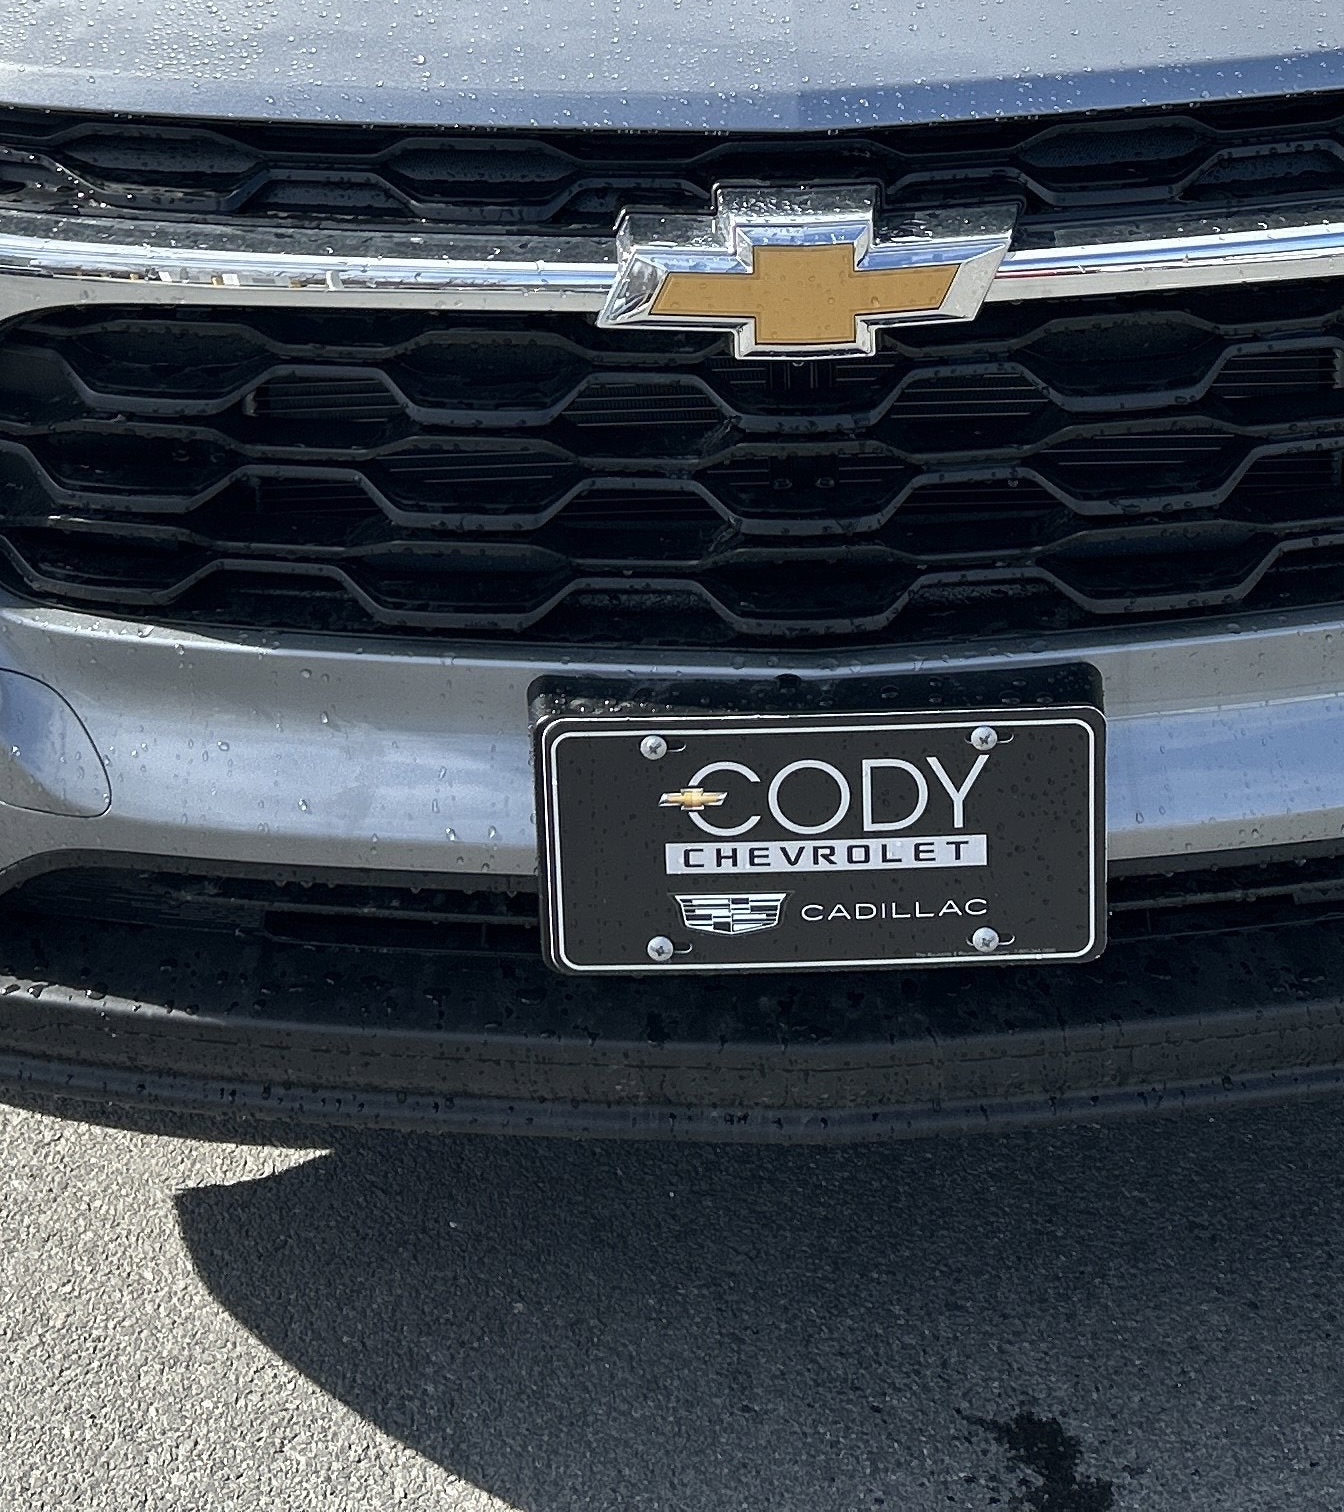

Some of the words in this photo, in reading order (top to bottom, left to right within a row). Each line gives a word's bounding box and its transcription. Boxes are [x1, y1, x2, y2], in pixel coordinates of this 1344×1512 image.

[687, 754, 990, 837] CODY
[684, 840, 970, 868] CHEVROLET
[801, 898, 989, 921] CADILLAC
